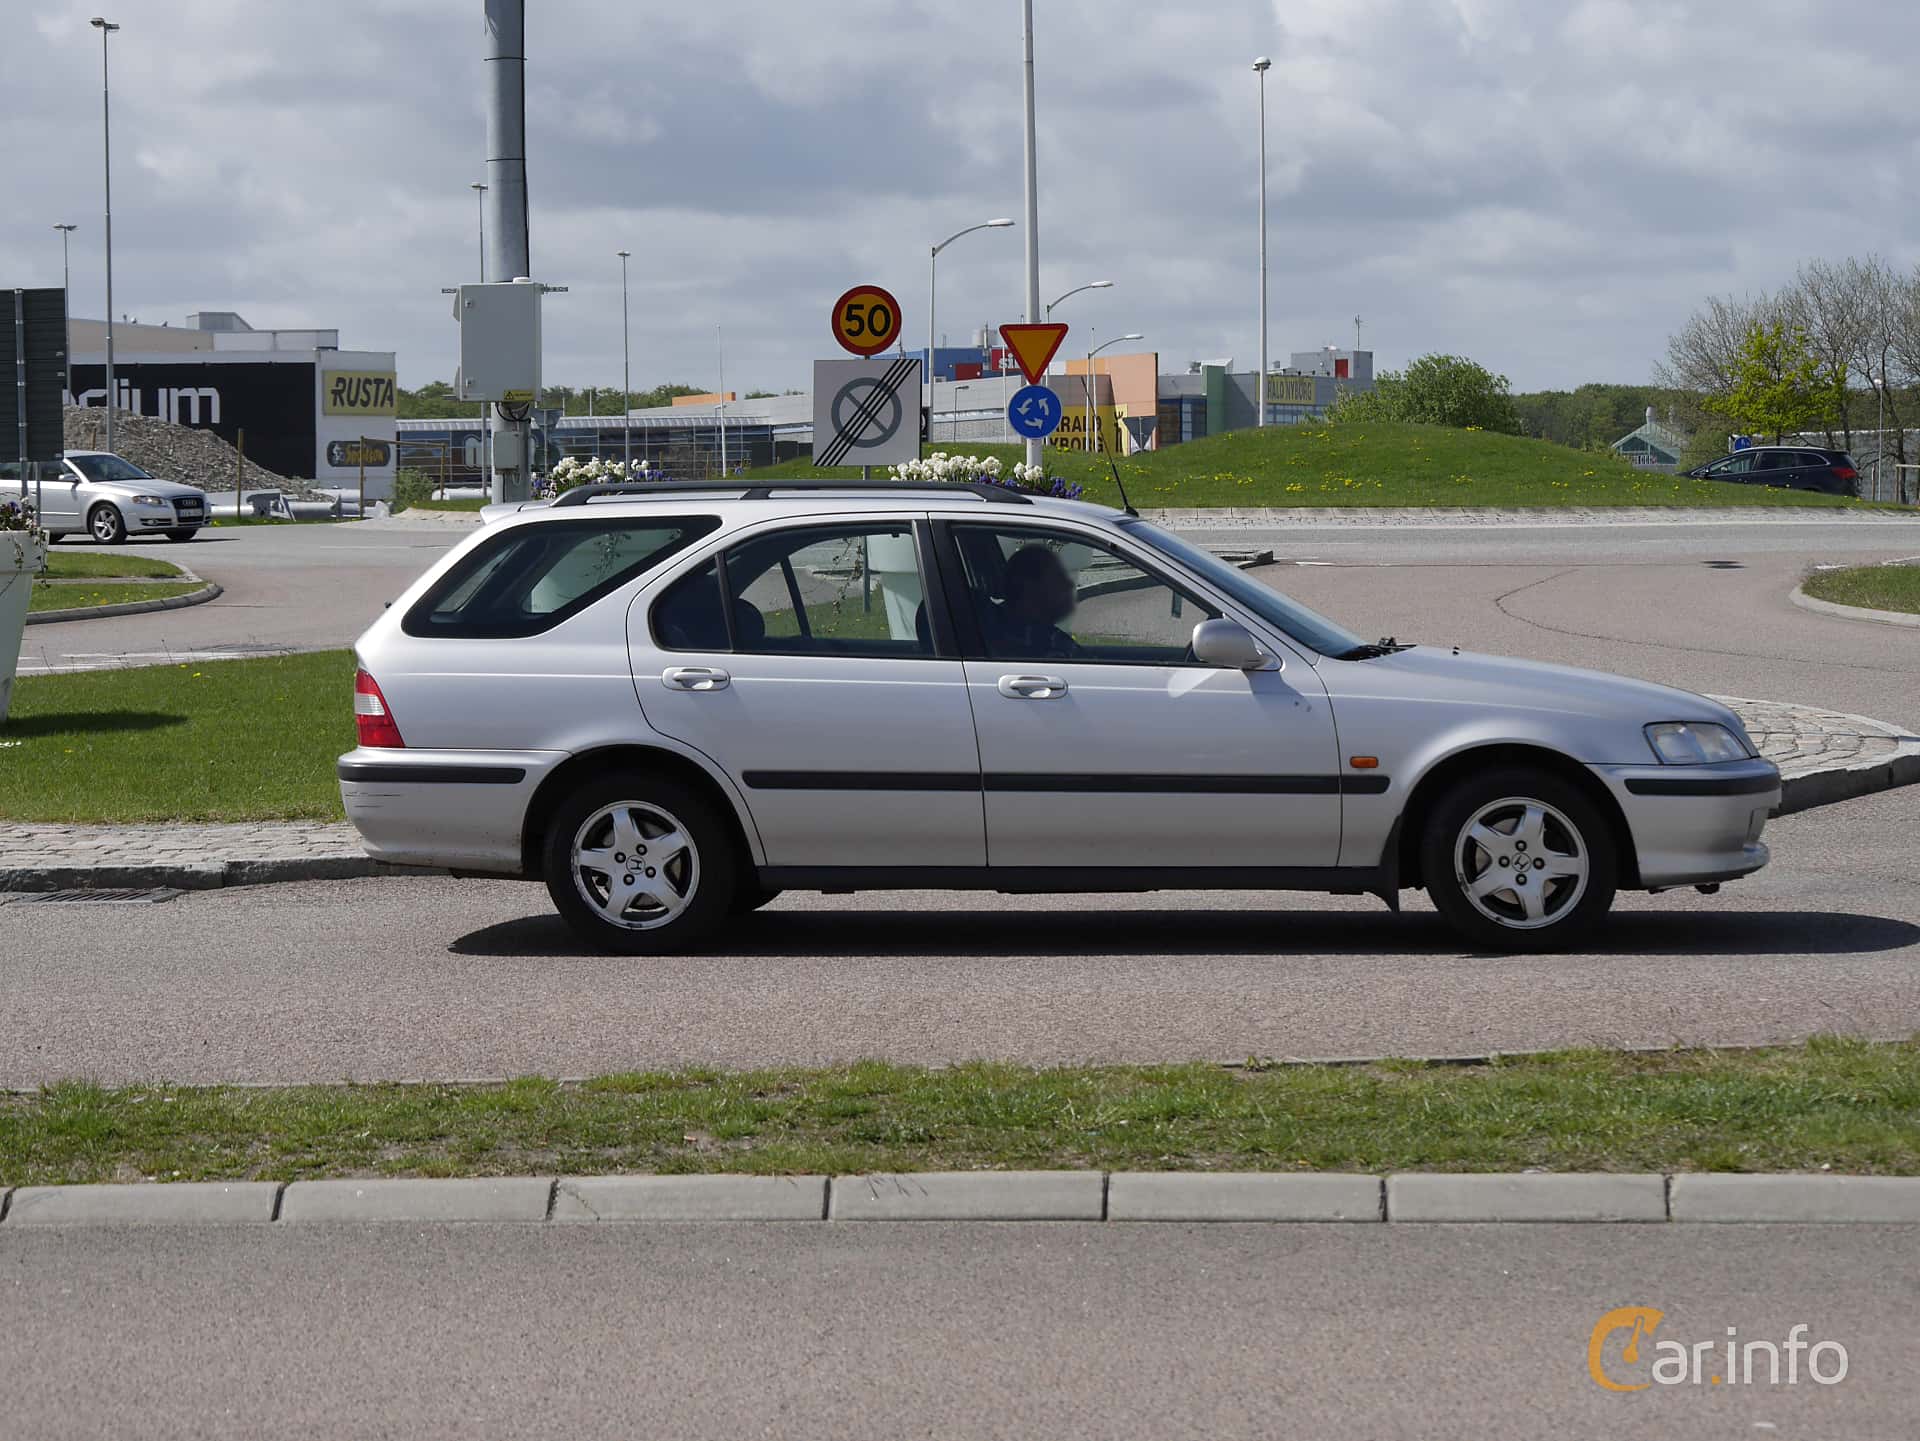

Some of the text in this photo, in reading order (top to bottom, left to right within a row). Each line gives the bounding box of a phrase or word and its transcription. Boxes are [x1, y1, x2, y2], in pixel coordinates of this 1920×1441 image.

[844, 303, 892, 338] 50
[331, 376, 394, 408] RUSTA
[1056, 415, 1103, 433] RALD
